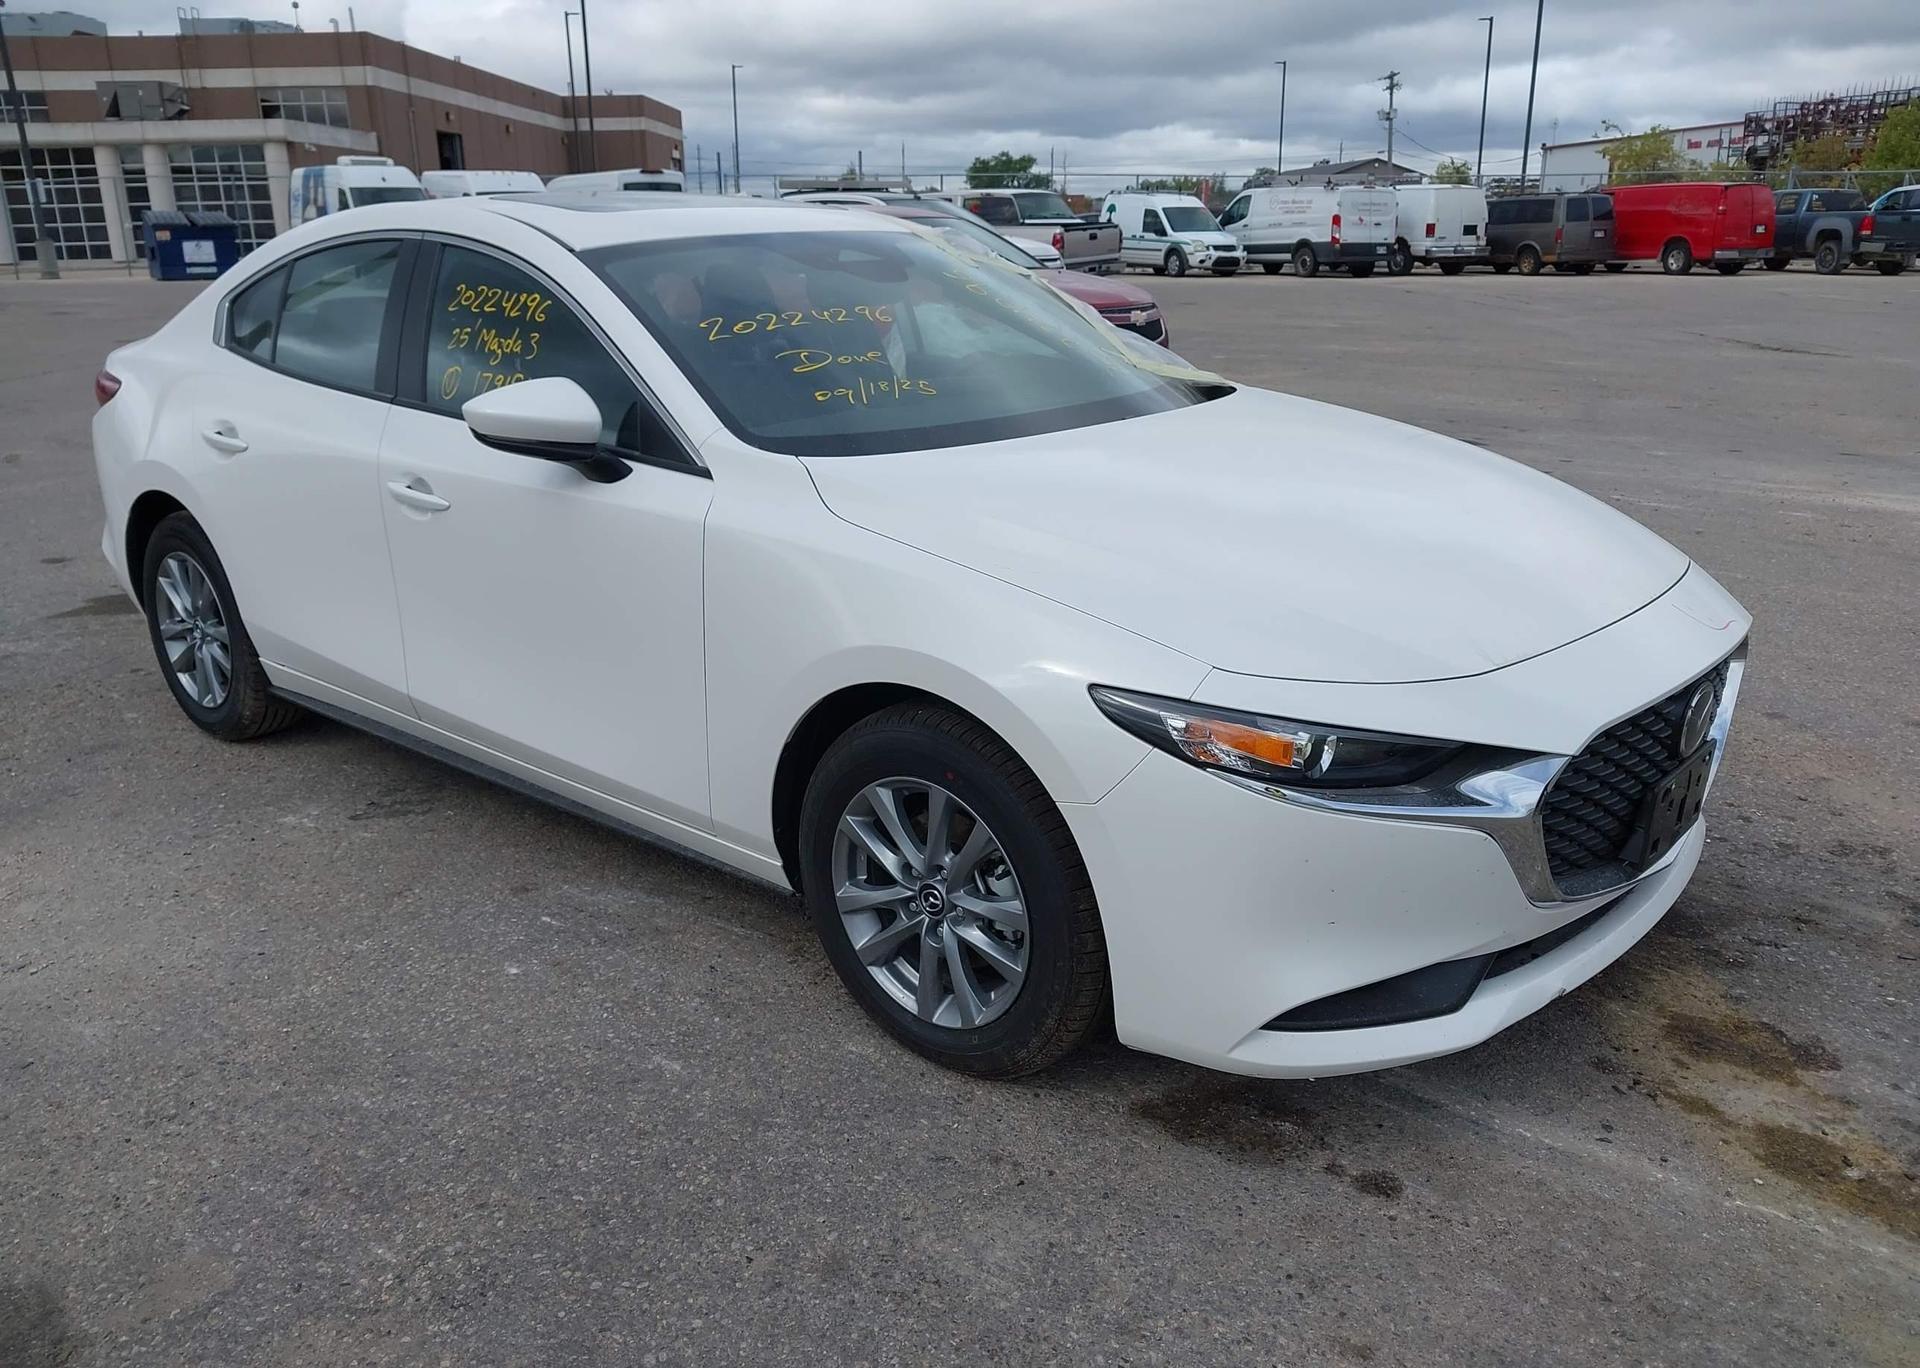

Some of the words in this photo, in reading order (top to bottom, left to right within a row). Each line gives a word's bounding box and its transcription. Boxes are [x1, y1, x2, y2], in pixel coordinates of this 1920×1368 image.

[448, 284, 552, 322] 20224296
[699, 306, 893, 341] 20224296
[524, 332, 541, 360] 3
[775, 349, 887, 373] Done
[815, 375, 937, 405] 09/18/25
